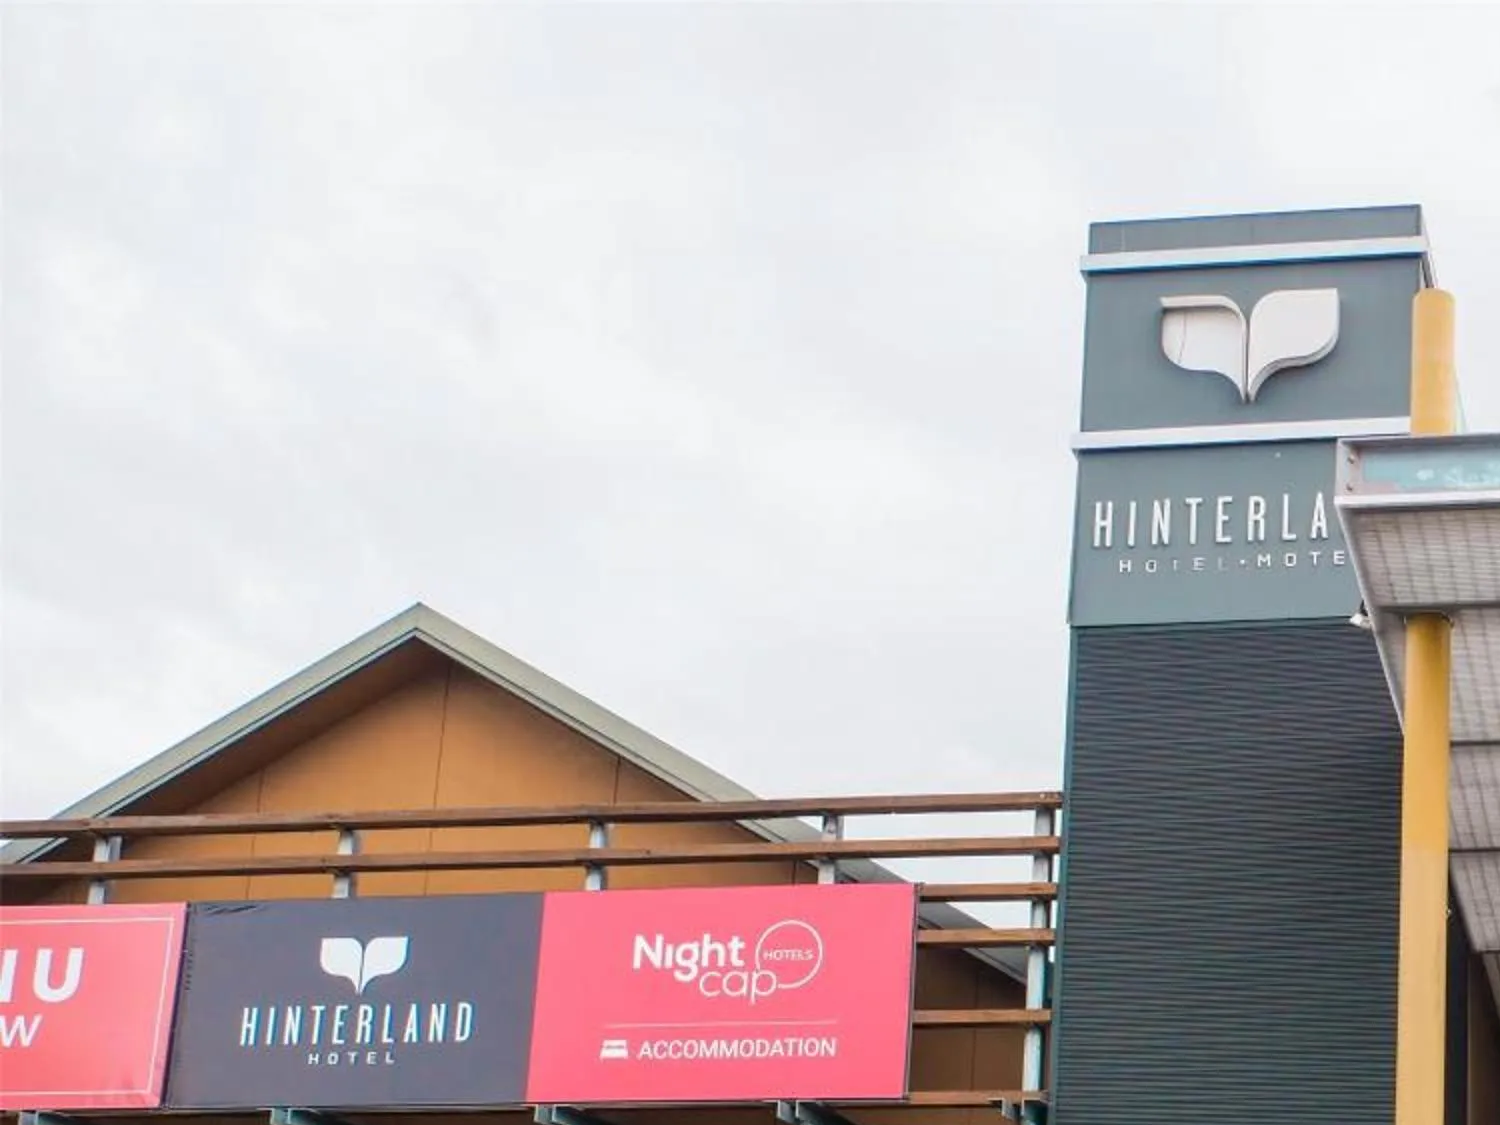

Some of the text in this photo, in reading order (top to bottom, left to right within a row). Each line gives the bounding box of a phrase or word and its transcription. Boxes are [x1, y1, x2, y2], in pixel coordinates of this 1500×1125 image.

[1093, 491, 1330, 548] HINTERLA
[632, 933, 746, 982] Night
[763, 948, 814, 962] HOTELS
[699, 970, 778, 1005] cap
[239, 1001, 475, 1047] HINTERLAND
[307, 1051, 396, 1065] HOTEL
[637, 1037, 837, 1060] ACCOMMODATION
